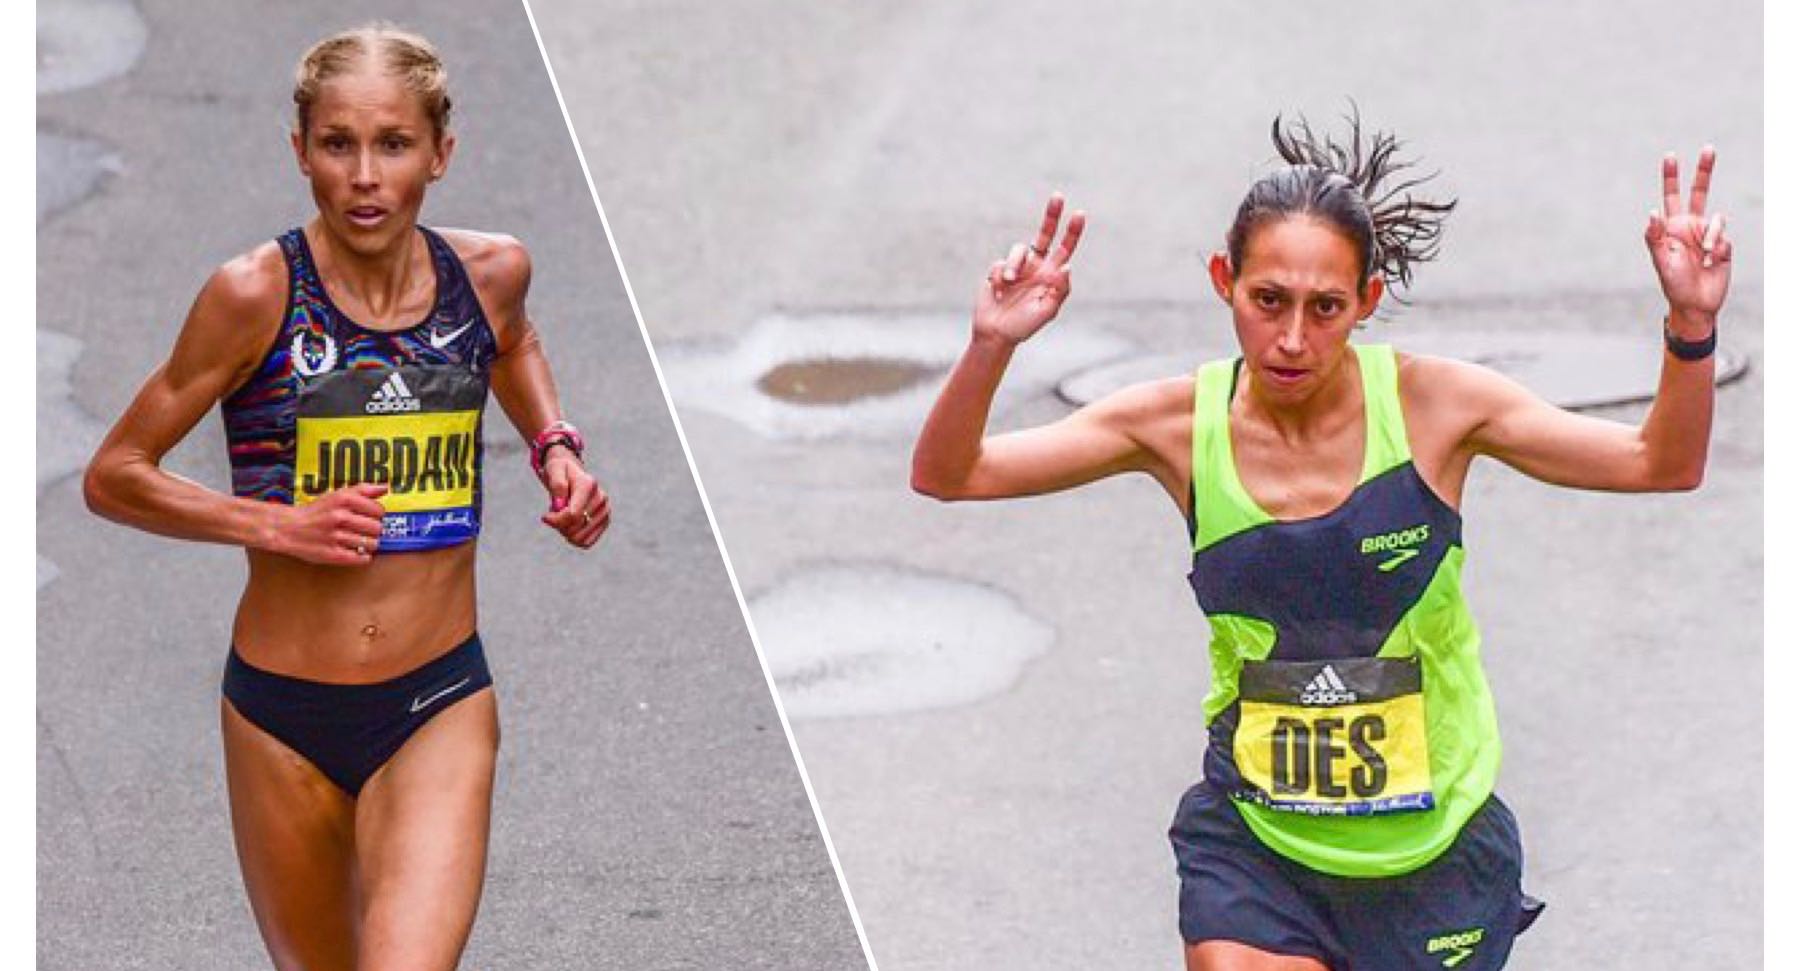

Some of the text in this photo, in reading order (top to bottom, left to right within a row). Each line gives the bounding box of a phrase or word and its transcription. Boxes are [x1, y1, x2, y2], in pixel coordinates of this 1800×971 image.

[302, 432, 470, 495] JORDAN
[1361, 525, 1430, 553] BROOKS
[1271, 713, 1388, 798] DES
